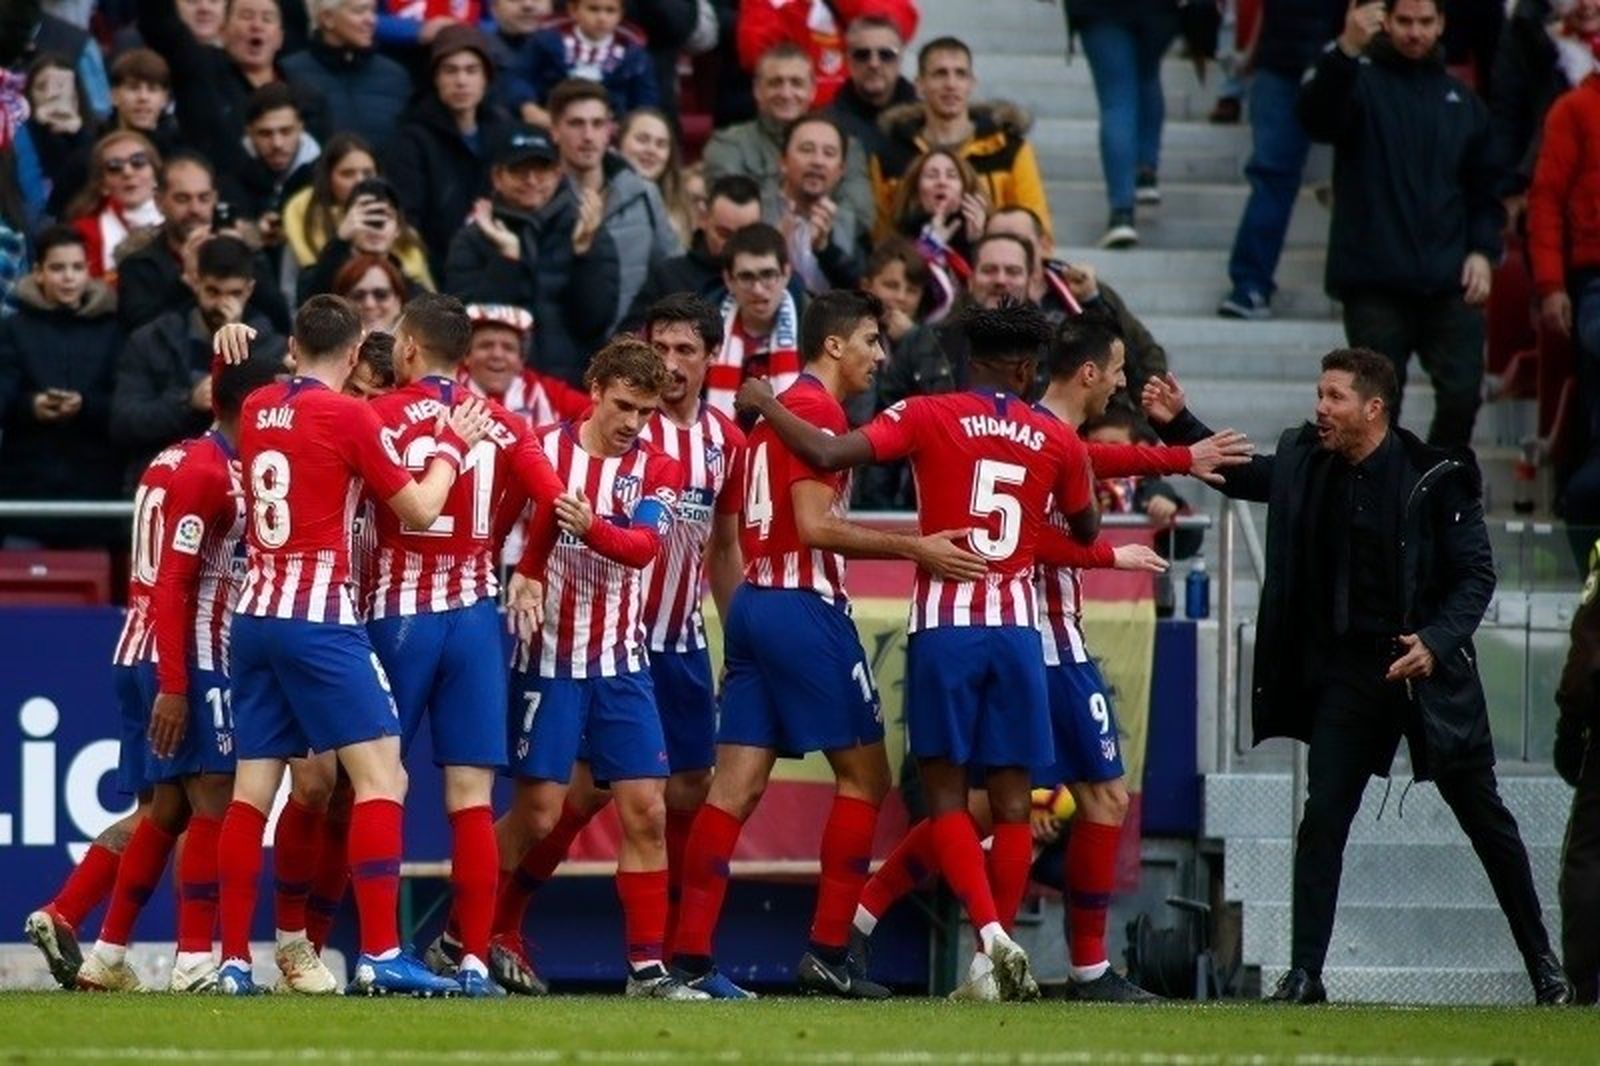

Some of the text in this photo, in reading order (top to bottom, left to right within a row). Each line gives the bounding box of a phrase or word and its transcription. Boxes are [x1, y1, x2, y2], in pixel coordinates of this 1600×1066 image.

[256, 404, 295, 430] SAÚL
[960, 414, 1046, 451] THOMAS
[251, 450, 291, 549] 8
[744, 441, 773, 540] 4
[967, 458, 1027, 561] 5
[130, 484, 166, 586] 10
[523, 691, 542, 732] 7
[1089, 693, 1109, 734] 9
